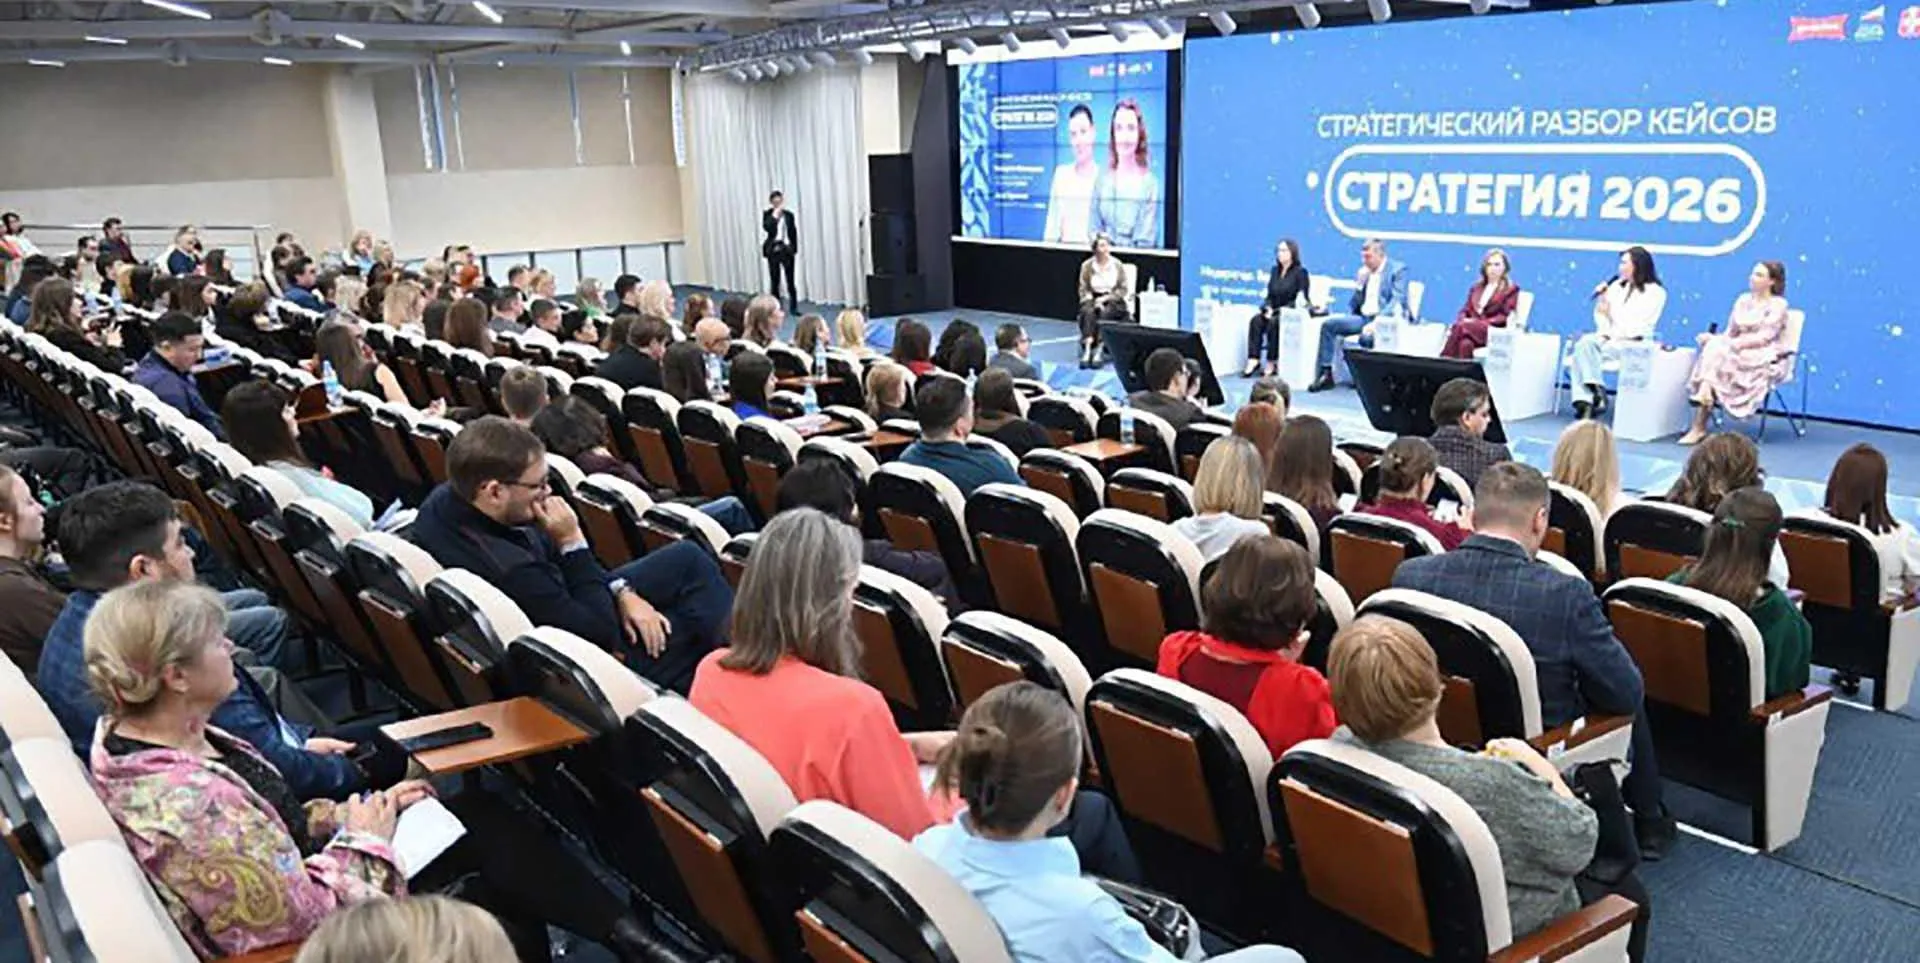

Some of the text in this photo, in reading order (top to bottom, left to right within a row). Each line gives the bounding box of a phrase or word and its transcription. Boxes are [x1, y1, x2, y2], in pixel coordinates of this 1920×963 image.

[1318, 102, 1777, 138] СТРАТЕГИЧЕСКИЙ РАЗБОР КЕЙСОВ
[1337, 171, 1741, 224] СТРАТЕГИЯ 2026
